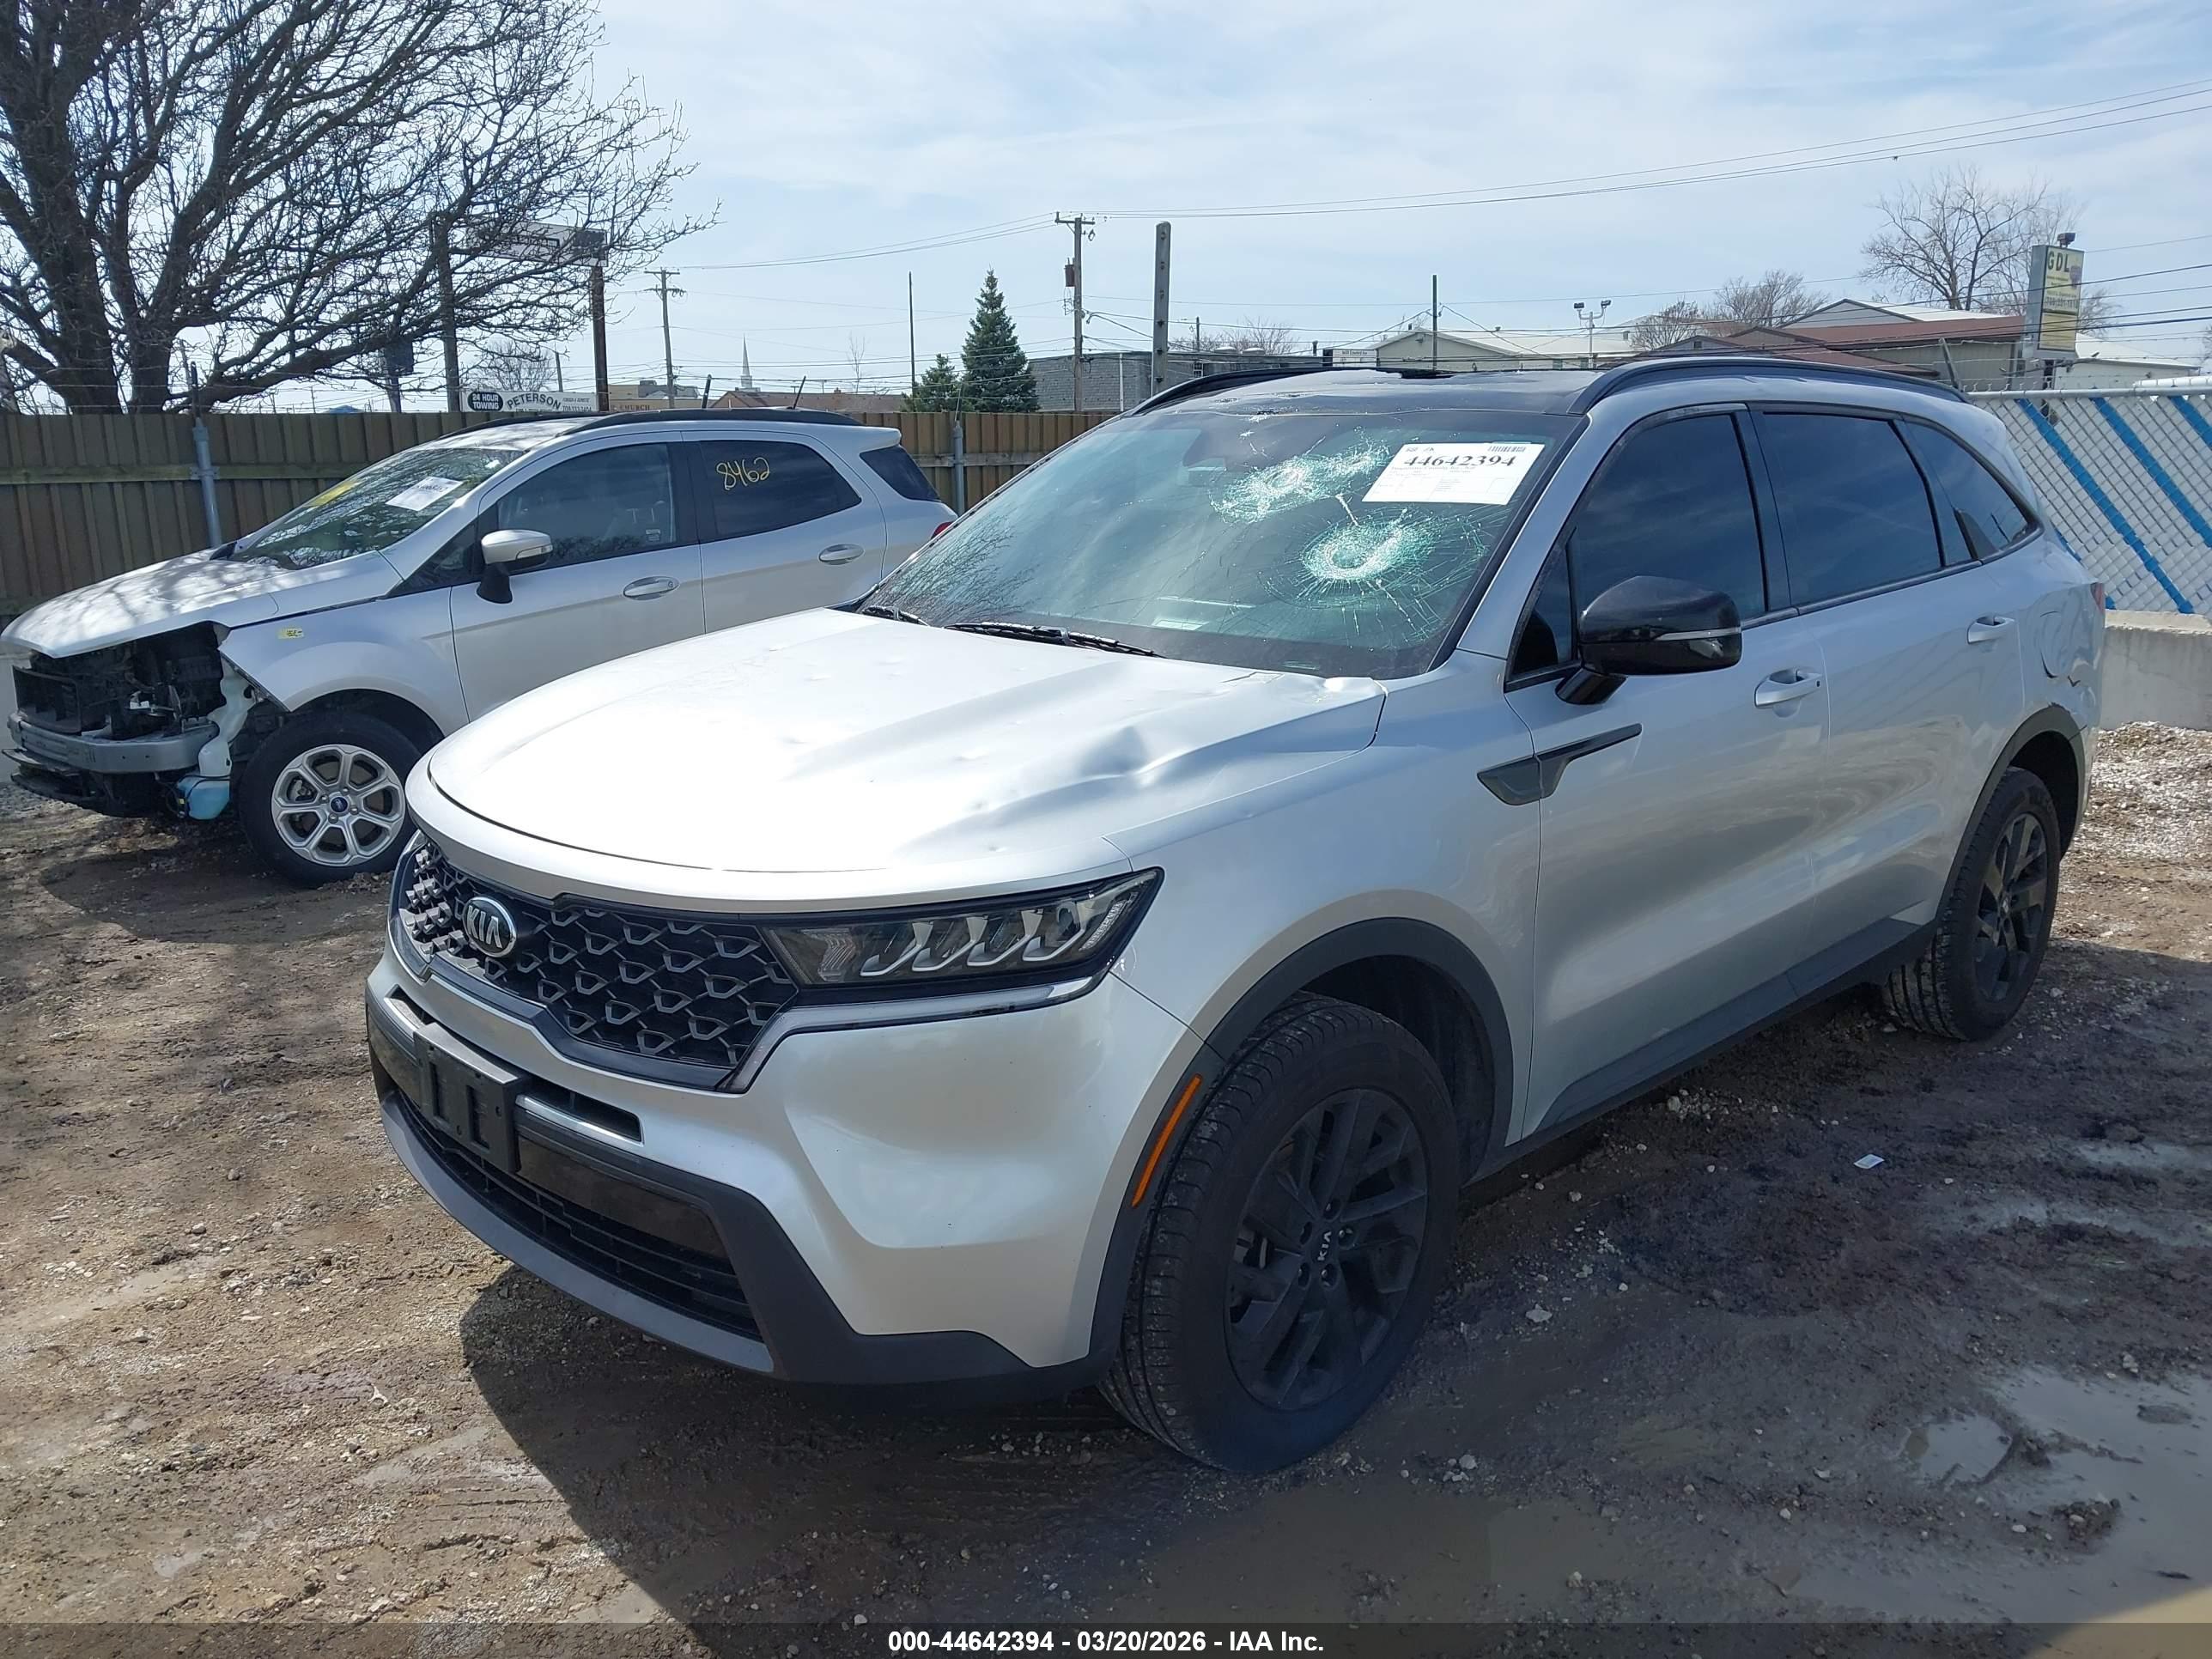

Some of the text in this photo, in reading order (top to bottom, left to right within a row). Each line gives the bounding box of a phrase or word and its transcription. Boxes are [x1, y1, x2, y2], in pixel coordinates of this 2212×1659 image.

[2047, 251, 2070, 272] GDL
[472, 393, 499, 402] 24 HOUR
[472, 401, 499, 410] TOWING
[507, 392, 562, 410] PETERSON
[1404, 455, 1516, 467] 44642394
[716, 457, 769, 490] 8462
[466, 905, 503, 949] KIA
[1317, 1231, 1333, 1261] KIA
